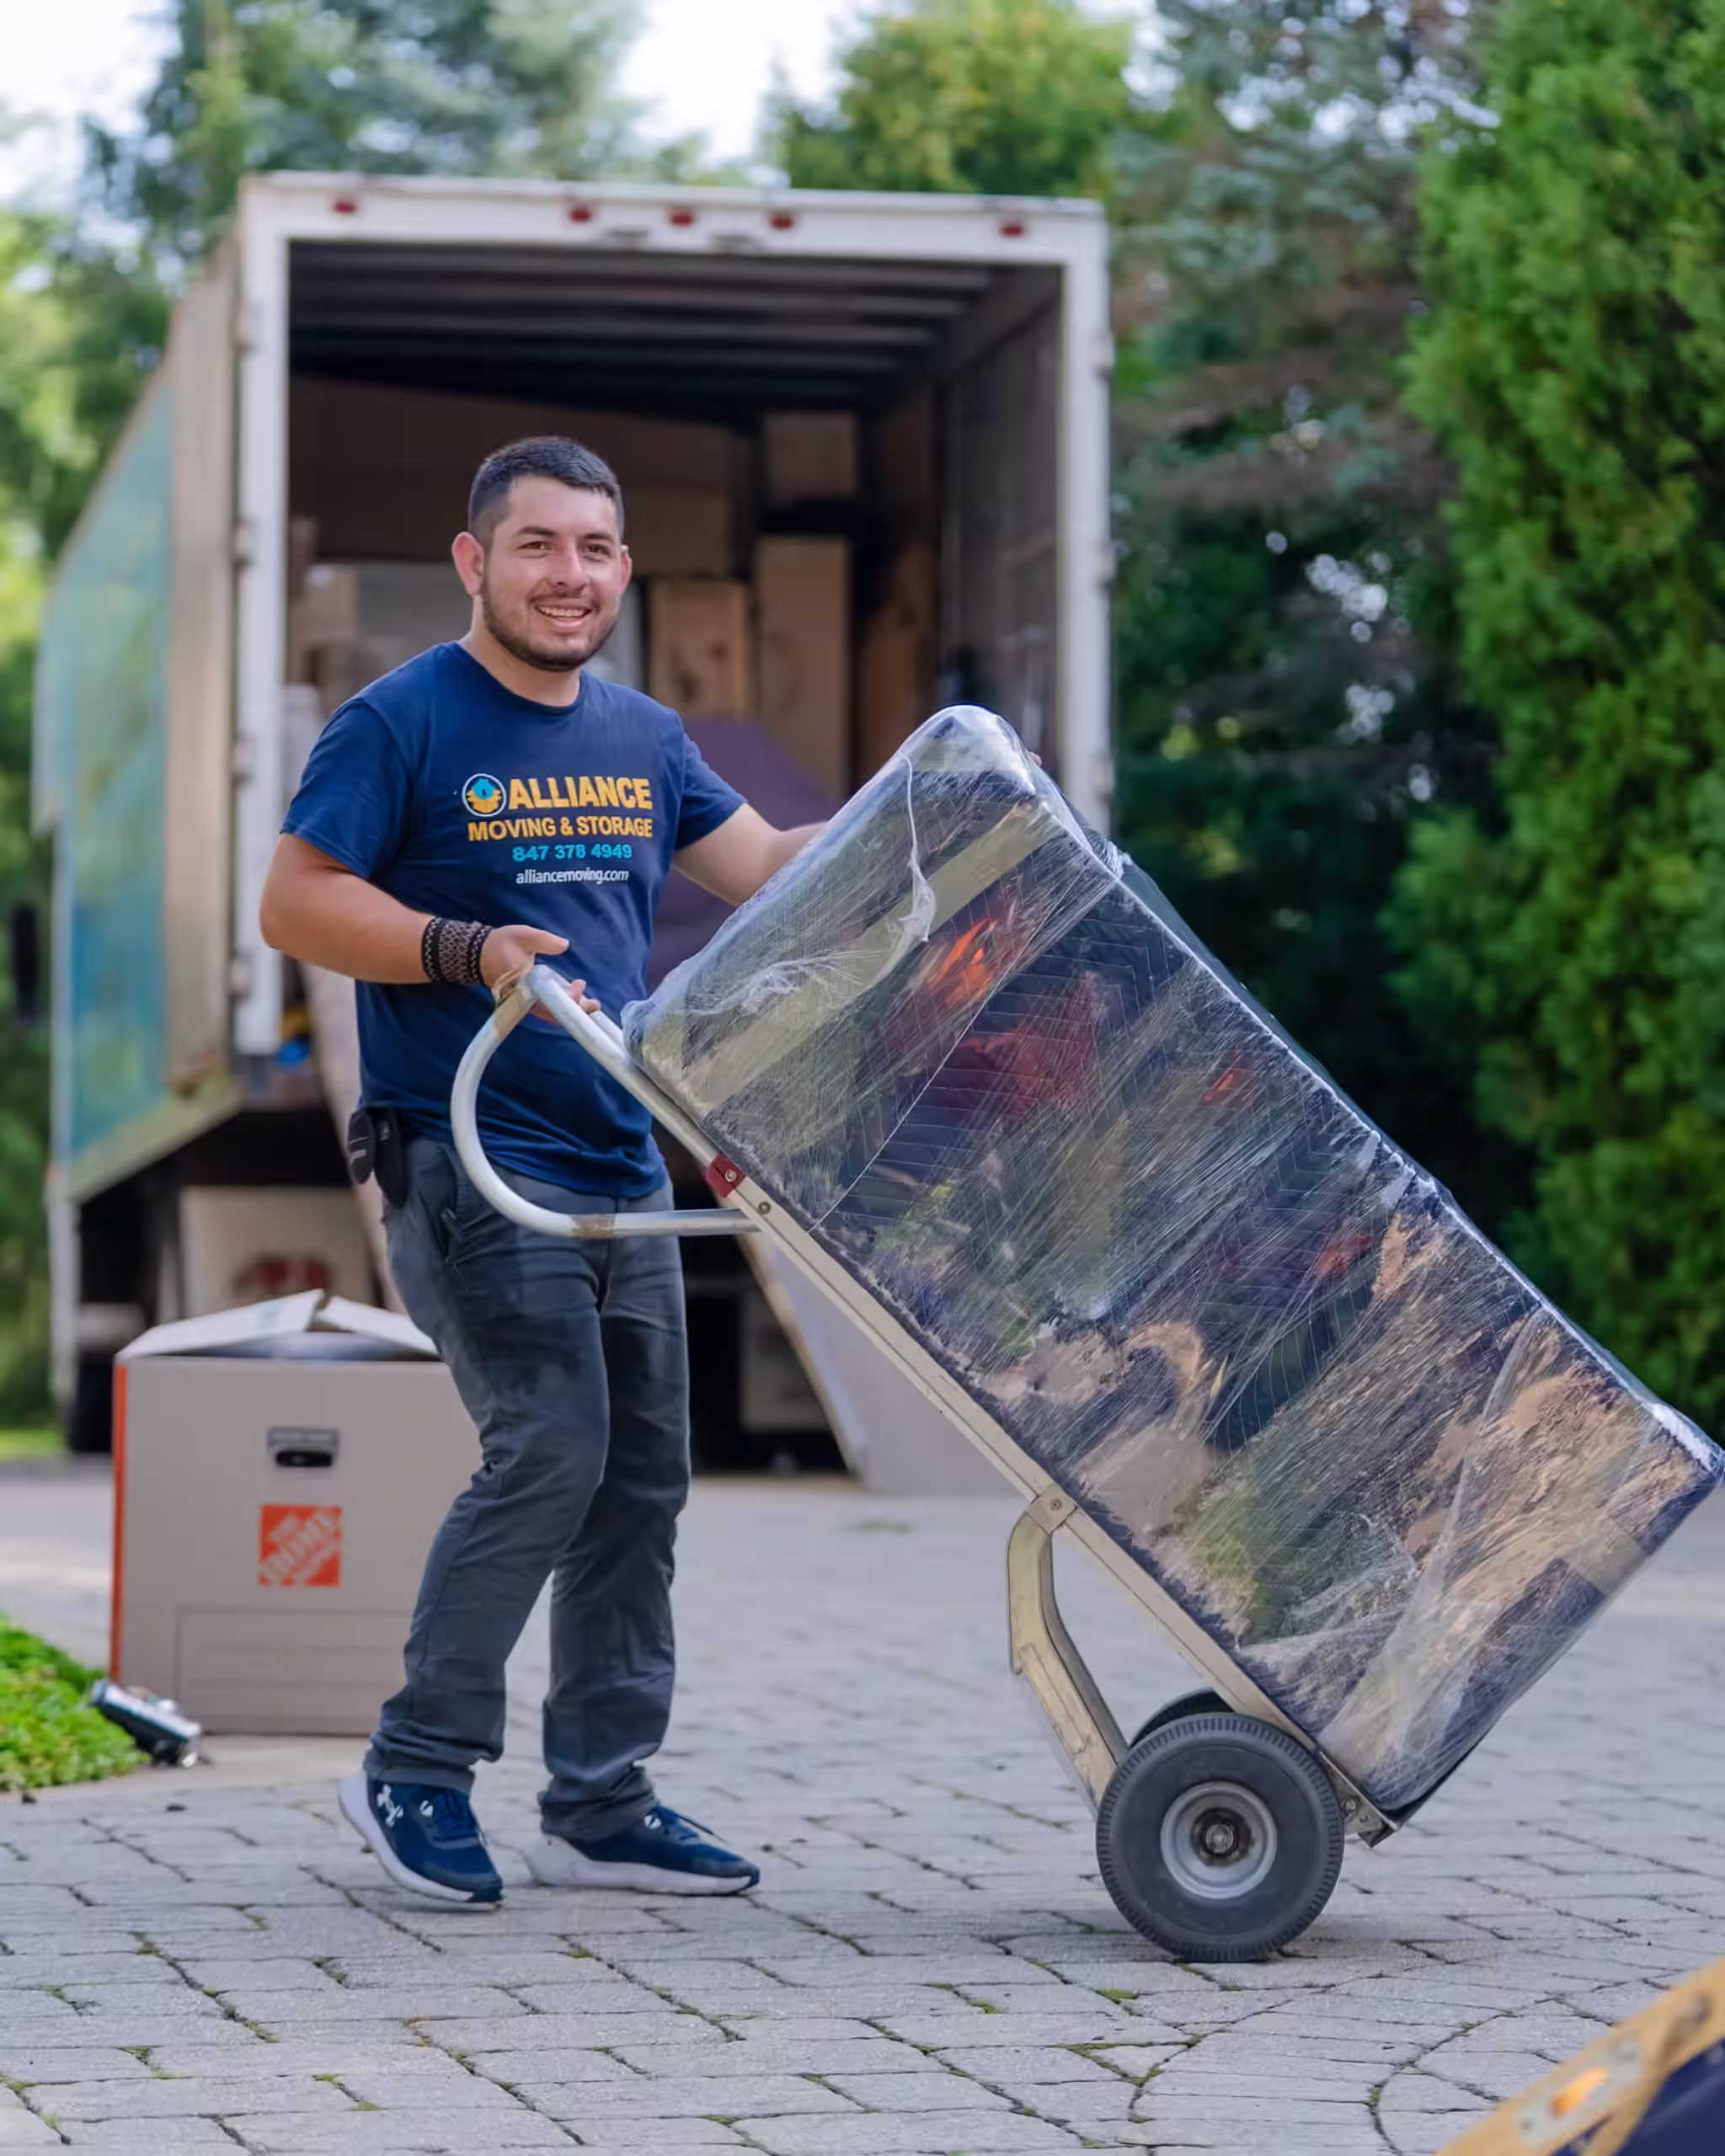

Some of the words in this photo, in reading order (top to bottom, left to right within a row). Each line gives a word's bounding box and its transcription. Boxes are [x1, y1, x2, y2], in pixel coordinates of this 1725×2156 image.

[509, 776, 653, 810] ALLIANCE
[467, 818, 556, 841] MOVING
[560, 817, 574, 835] &
[576, 816, 653, 837] STORAGE
[512, 846, 549, 862] 847
[554, 844, 585, 859] 378
[590, 843, 633, 858] 4949
[515, 867, 629, 884] alliancemoving.com
